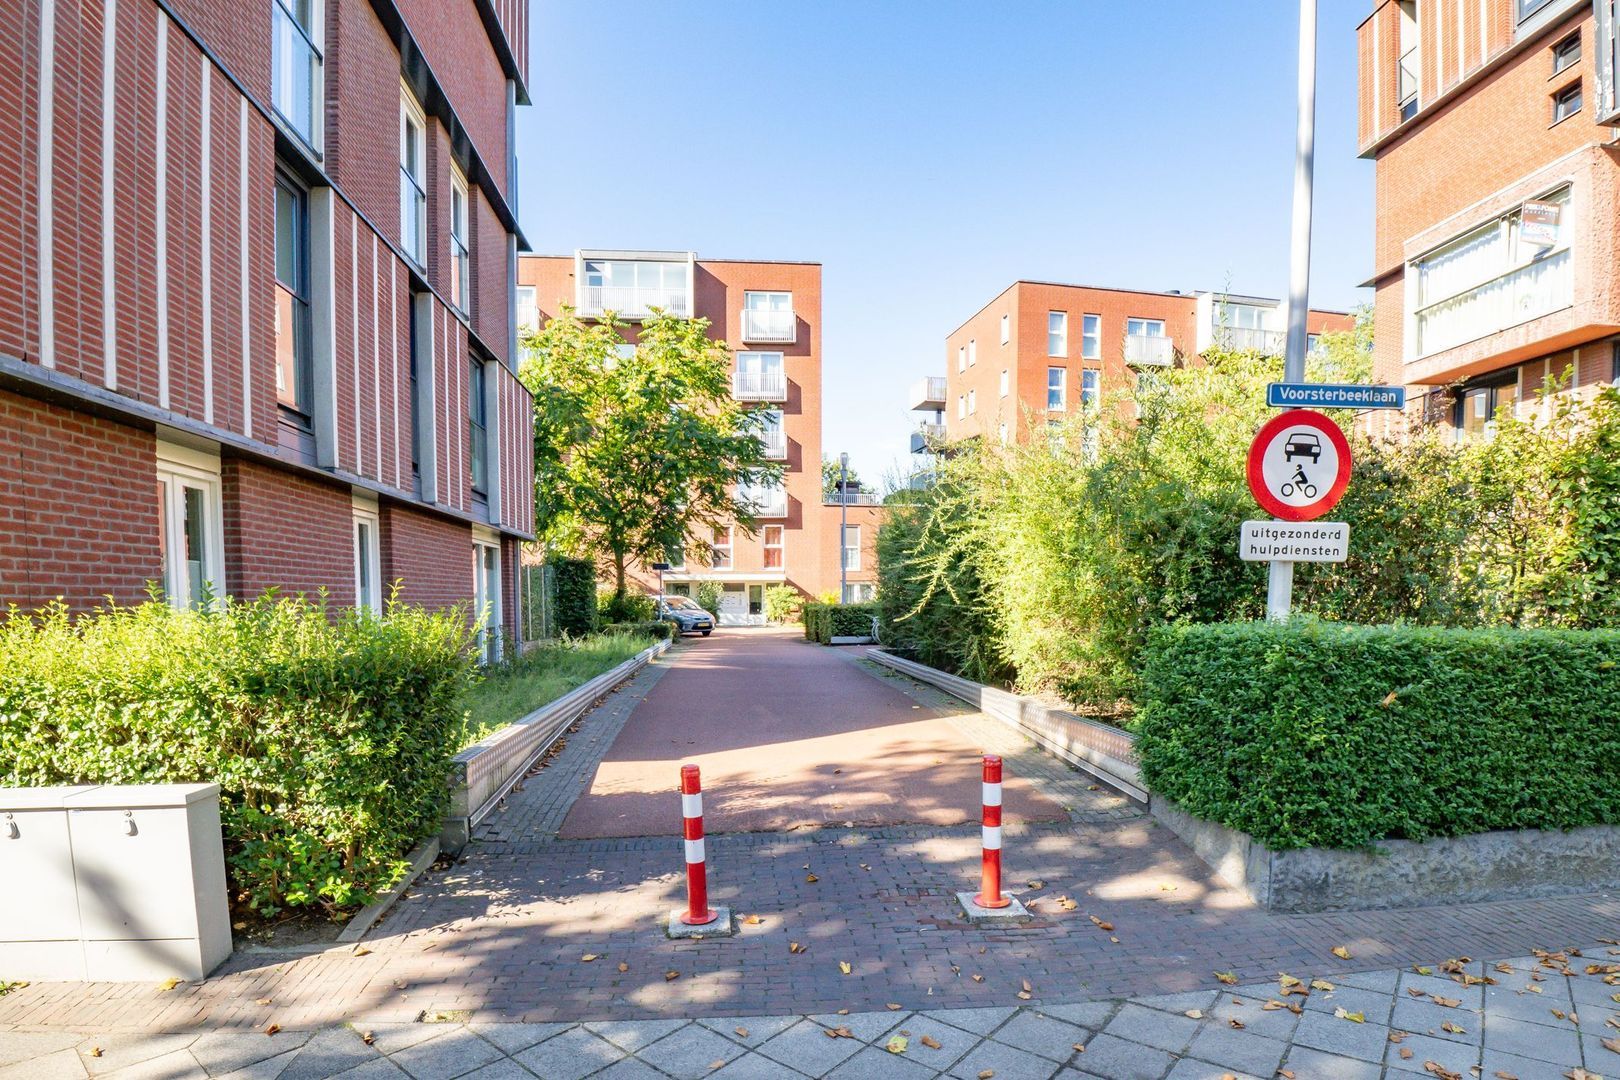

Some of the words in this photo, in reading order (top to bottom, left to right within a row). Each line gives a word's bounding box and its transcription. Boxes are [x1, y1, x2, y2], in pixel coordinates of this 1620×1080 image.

[1279, 386, 1396, 403] Voorsterbeeklaan
[1251, 527, 1341, 541] uitgezonderd
[1250, 544, 1340, 556] hulpdiensten
